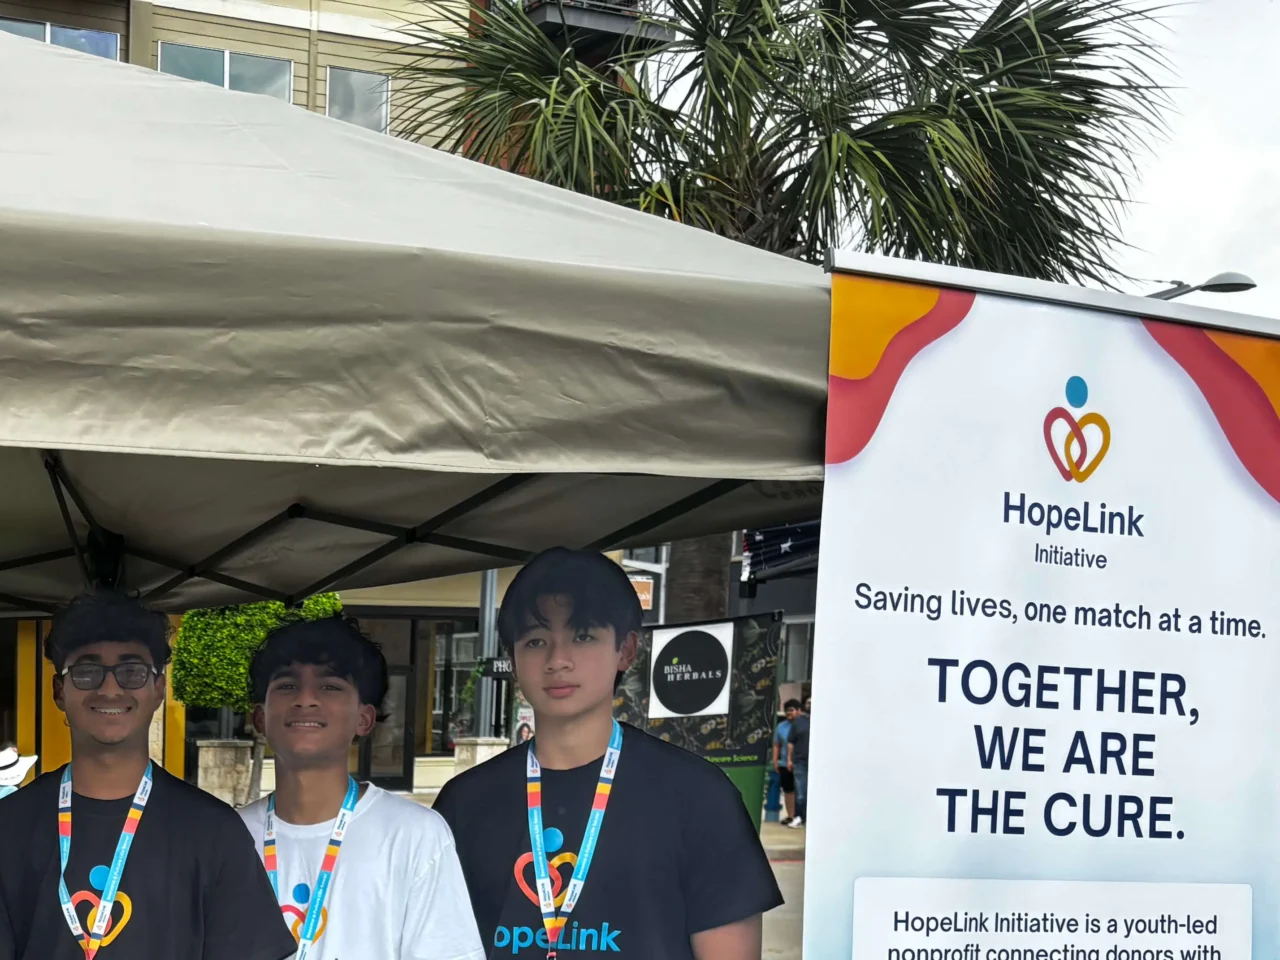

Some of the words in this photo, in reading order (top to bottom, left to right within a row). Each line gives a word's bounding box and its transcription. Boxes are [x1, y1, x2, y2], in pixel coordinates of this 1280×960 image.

[1004, 492, 1144, 537] HopeLink
[1035, 543, 1107, 569] Initiative
[854, 583, 942, 621] Saving
[951, 590, 1018, 624] lives,
[1025, 601, 1066, 623] one
[1075, 604, 1151, 629] match
[1158, 608, 1181, 632] at
[1189, 616, 1202, 633] a
[1210, 611, 1266, 638] time.
[664, 664, 692, 674] BISHA
[667, 670, 721, 681] HERBALS
[928, 658, 1199, 725] TOGETHER,
[974, 725, 1046, 772] WE
[1062, 730, 1156, 776] ARE
[936, 788, 1026, 835] THE
[1044, 792, 1184, 839] CURE.
[494, 921, 621, 951] opeLink
[893, 911, 989, 937] HopeLink
[995, 913, 1079, 934] Initiative
[1085, 914, 1100, 934] is
[1107, 918, 1117, 934] a
[1124, 914, 1217, 938] youth-led
